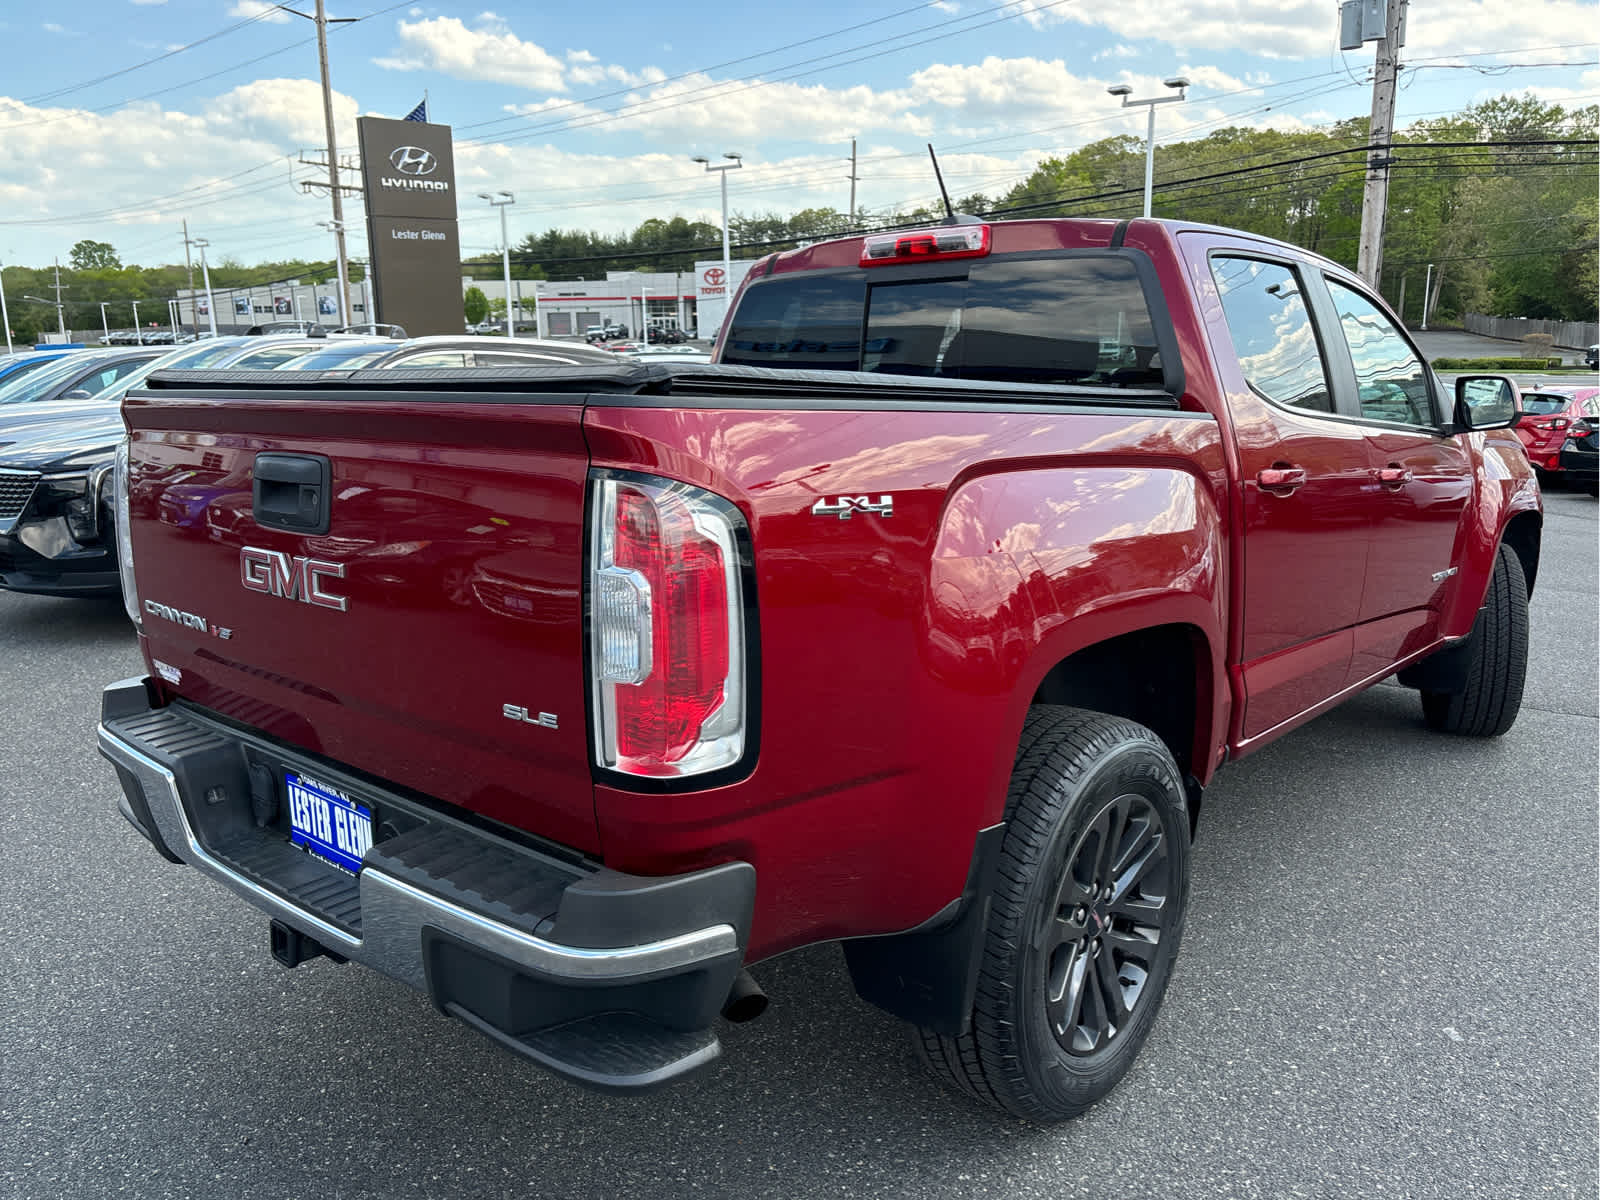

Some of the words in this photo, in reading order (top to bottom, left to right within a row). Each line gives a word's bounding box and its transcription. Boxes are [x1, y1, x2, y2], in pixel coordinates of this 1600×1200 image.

[381, 177, 449, 190] HYUNDAI
[391, 229, 419, 240] Lester
[421, 230, 446, 241] Glenn
[701, 286, 733, 296] TOYOT
[240, 545, 348, 613] GMC
[144, 599, 208, 633] CANYON
[503, 703, 559, 729] SLE
[287, 784, 332, 845] LESTER
[334, 805, 373, 859] GLENN
